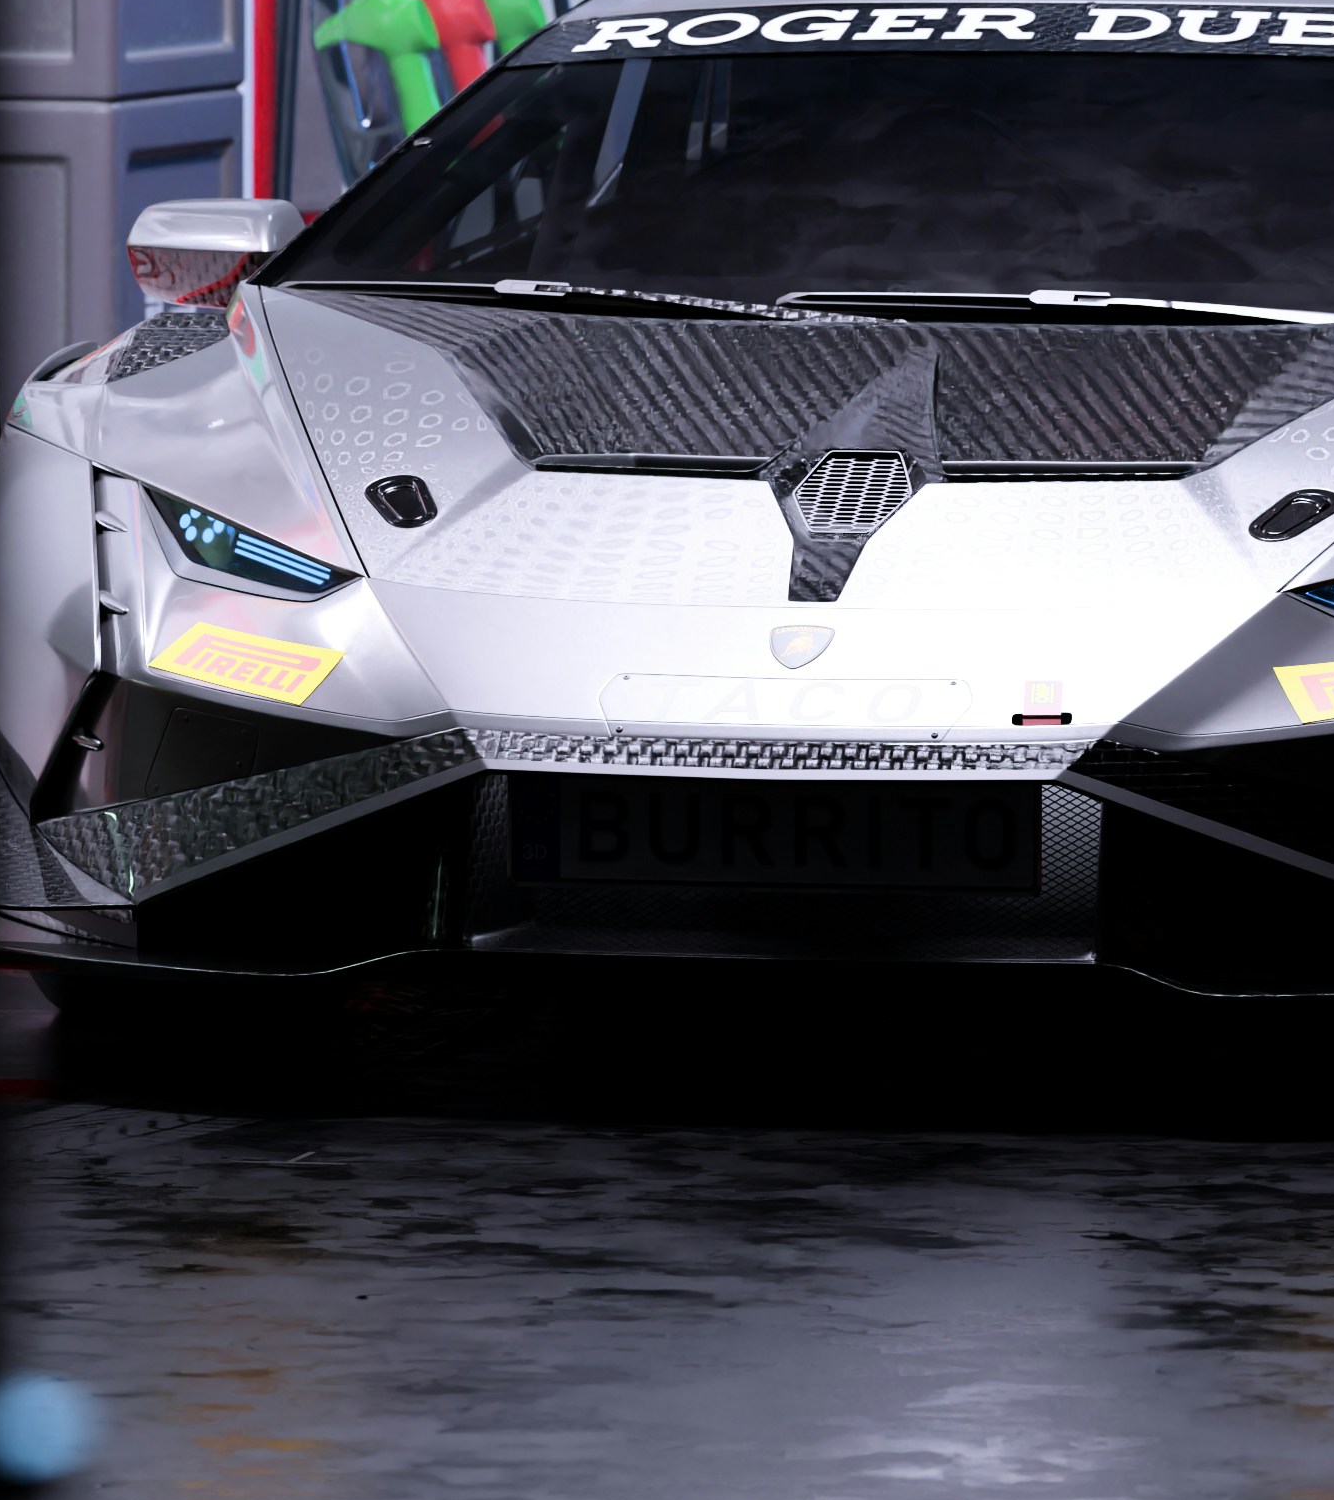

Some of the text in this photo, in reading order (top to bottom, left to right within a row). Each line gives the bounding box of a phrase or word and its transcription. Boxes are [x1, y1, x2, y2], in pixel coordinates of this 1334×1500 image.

[572, 8, 1036, 53] ROGER
[172, 633, 322, 695] PIRELLI
[649, 678, 924, 724] TACO
[521, 844, 548, 861] 3D
[579, 790, 1017, 871] BURRITO
